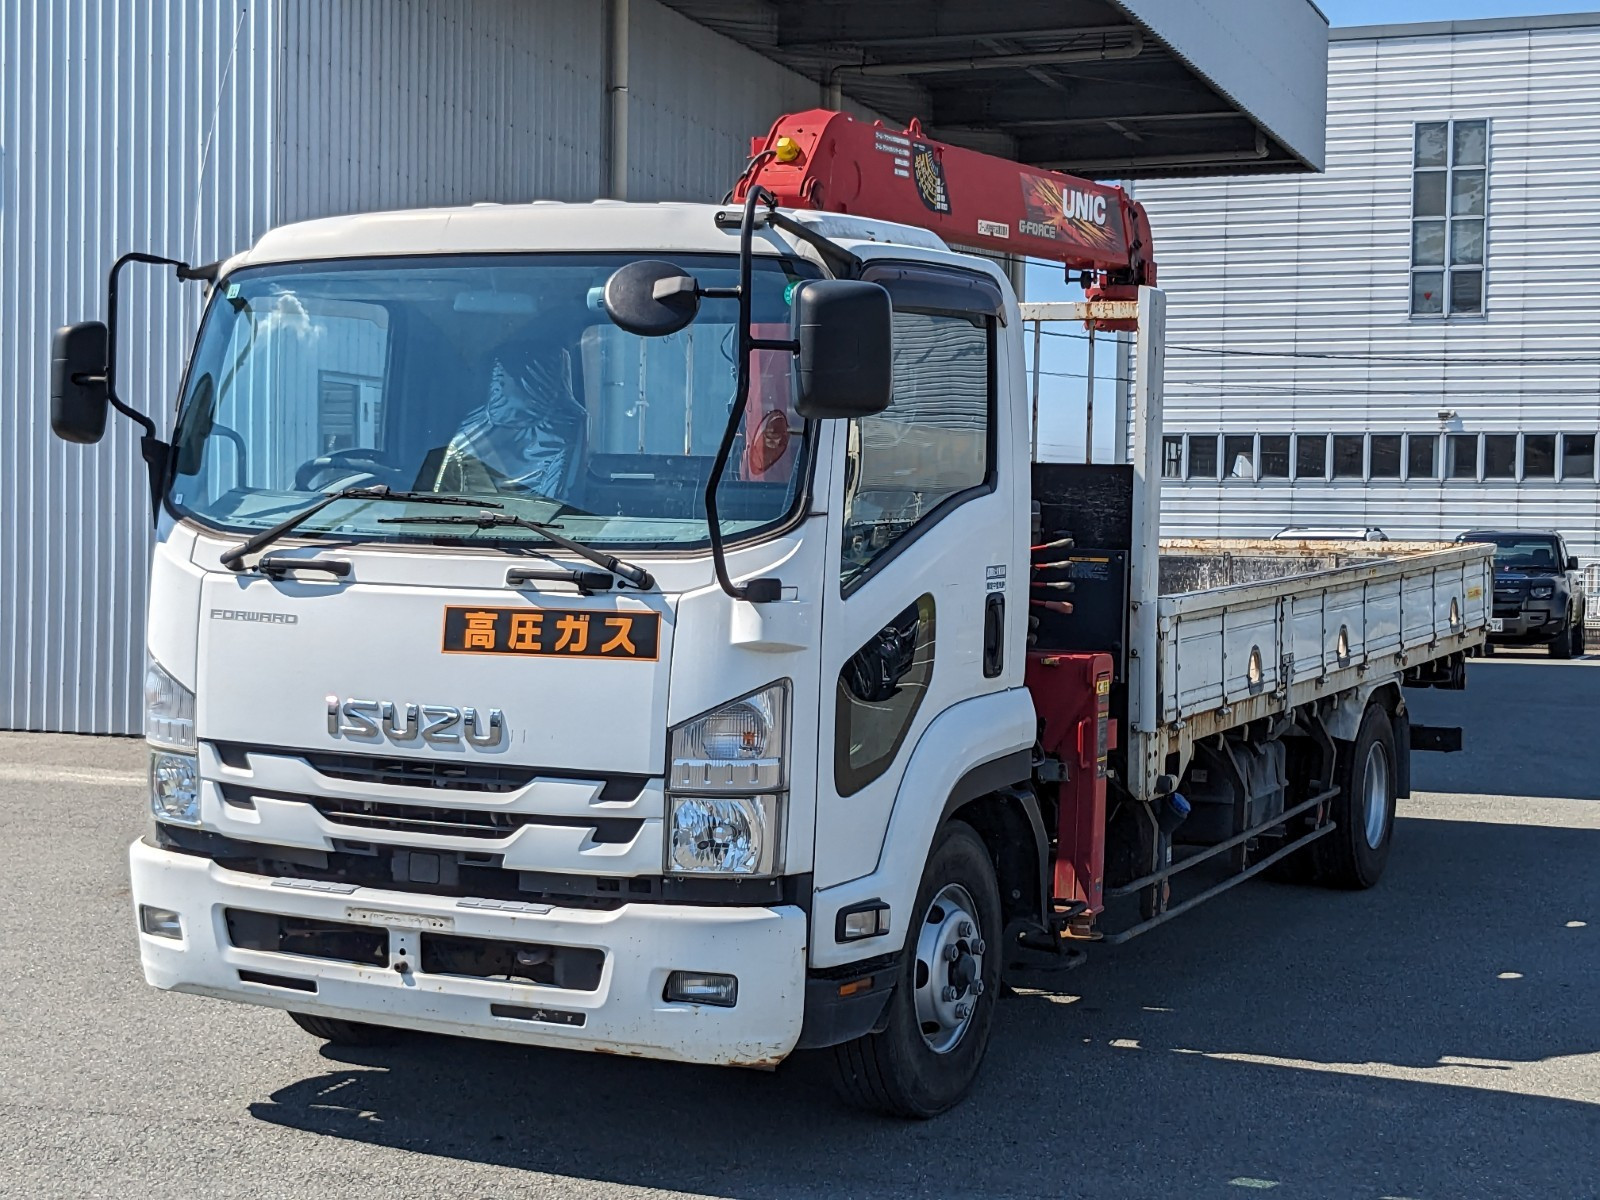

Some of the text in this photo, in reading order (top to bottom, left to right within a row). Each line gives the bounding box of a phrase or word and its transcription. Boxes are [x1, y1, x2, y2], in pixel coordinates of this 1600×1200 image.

[1062, 188, 1106, 226] UNIC
[210, 608, 298, 625] FORWARD
[464, 611, 636, 655] 高圧ガス
[326, 696, 502, 747] ISUZU
